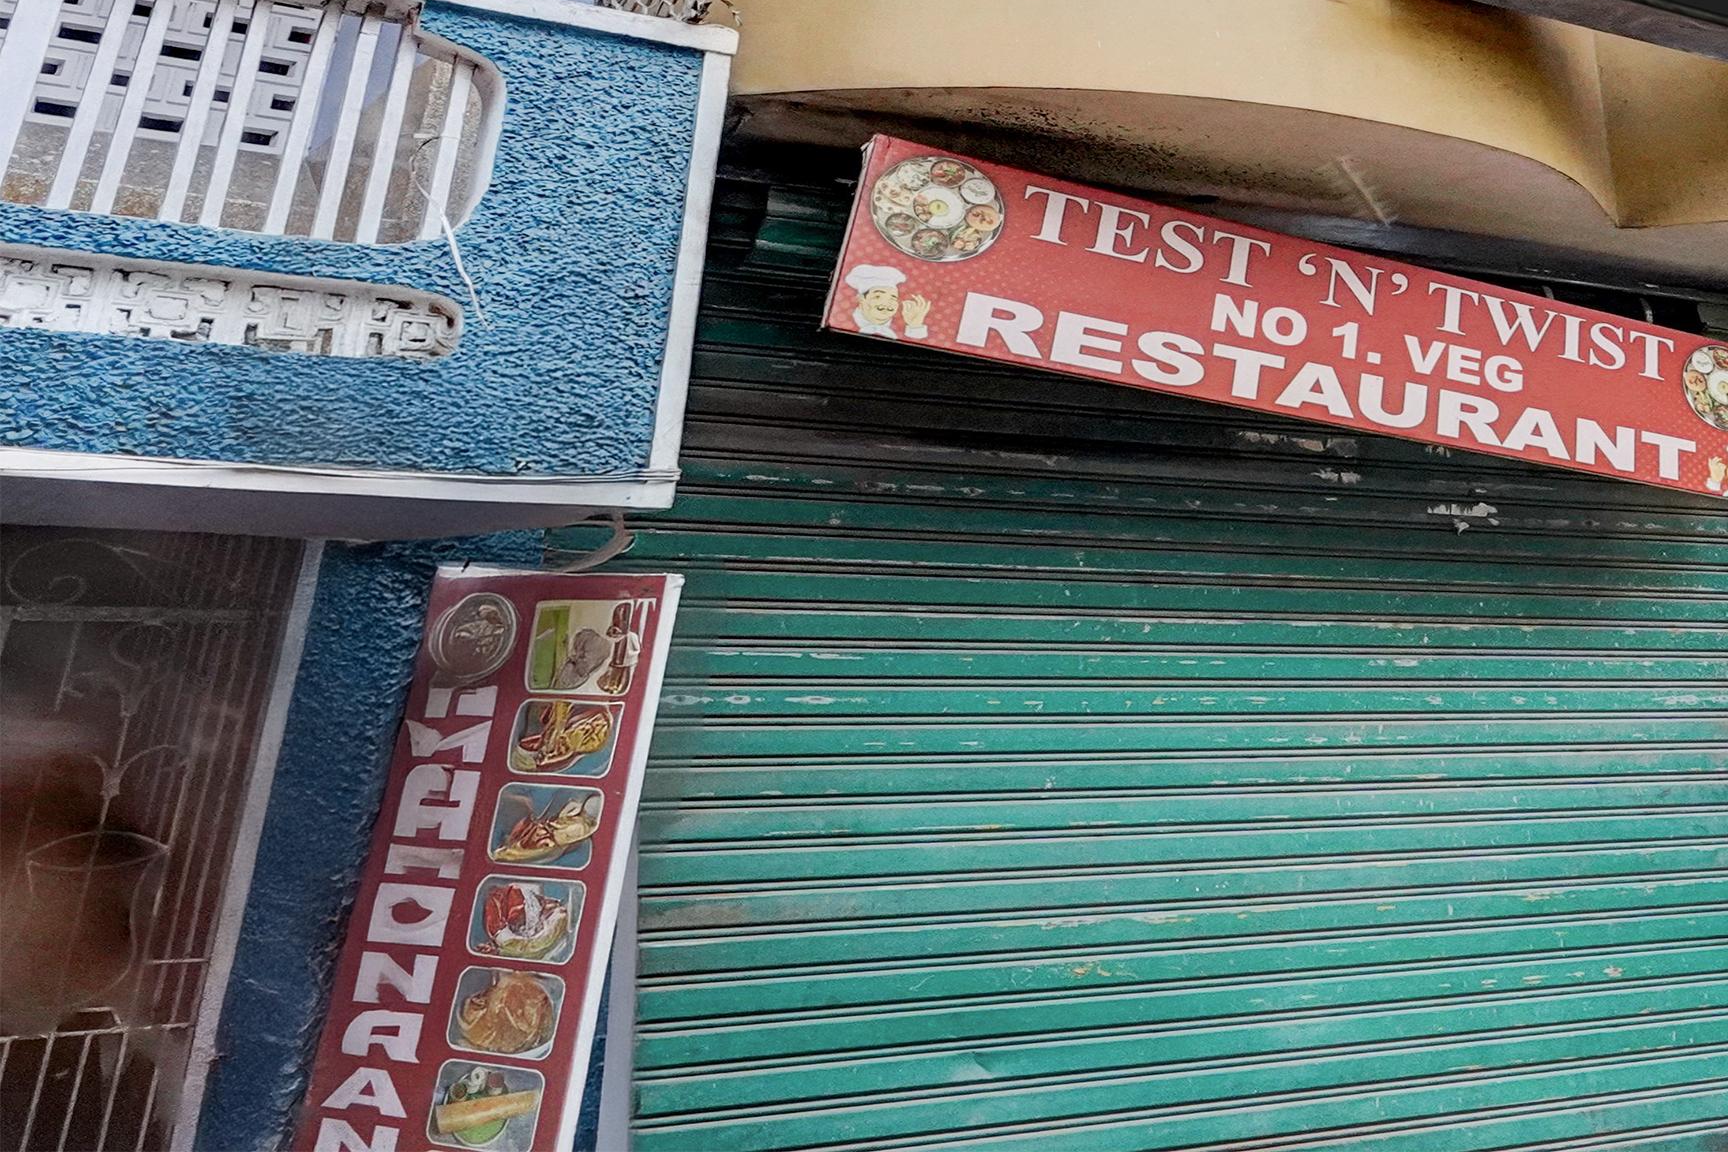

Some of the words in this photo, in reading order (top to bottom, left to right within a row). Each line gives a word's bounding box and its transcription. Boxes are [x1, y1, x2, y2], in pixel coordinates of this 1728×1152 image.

[1023, 184, 1272, 287] TEST
[1427, 281, 1675, 382] TWIST
[1209, 294, 1308, 347] NO
[1404, 334, 1525, 393] VEG
[955, 291, 1697, 482] RESTAURANT
